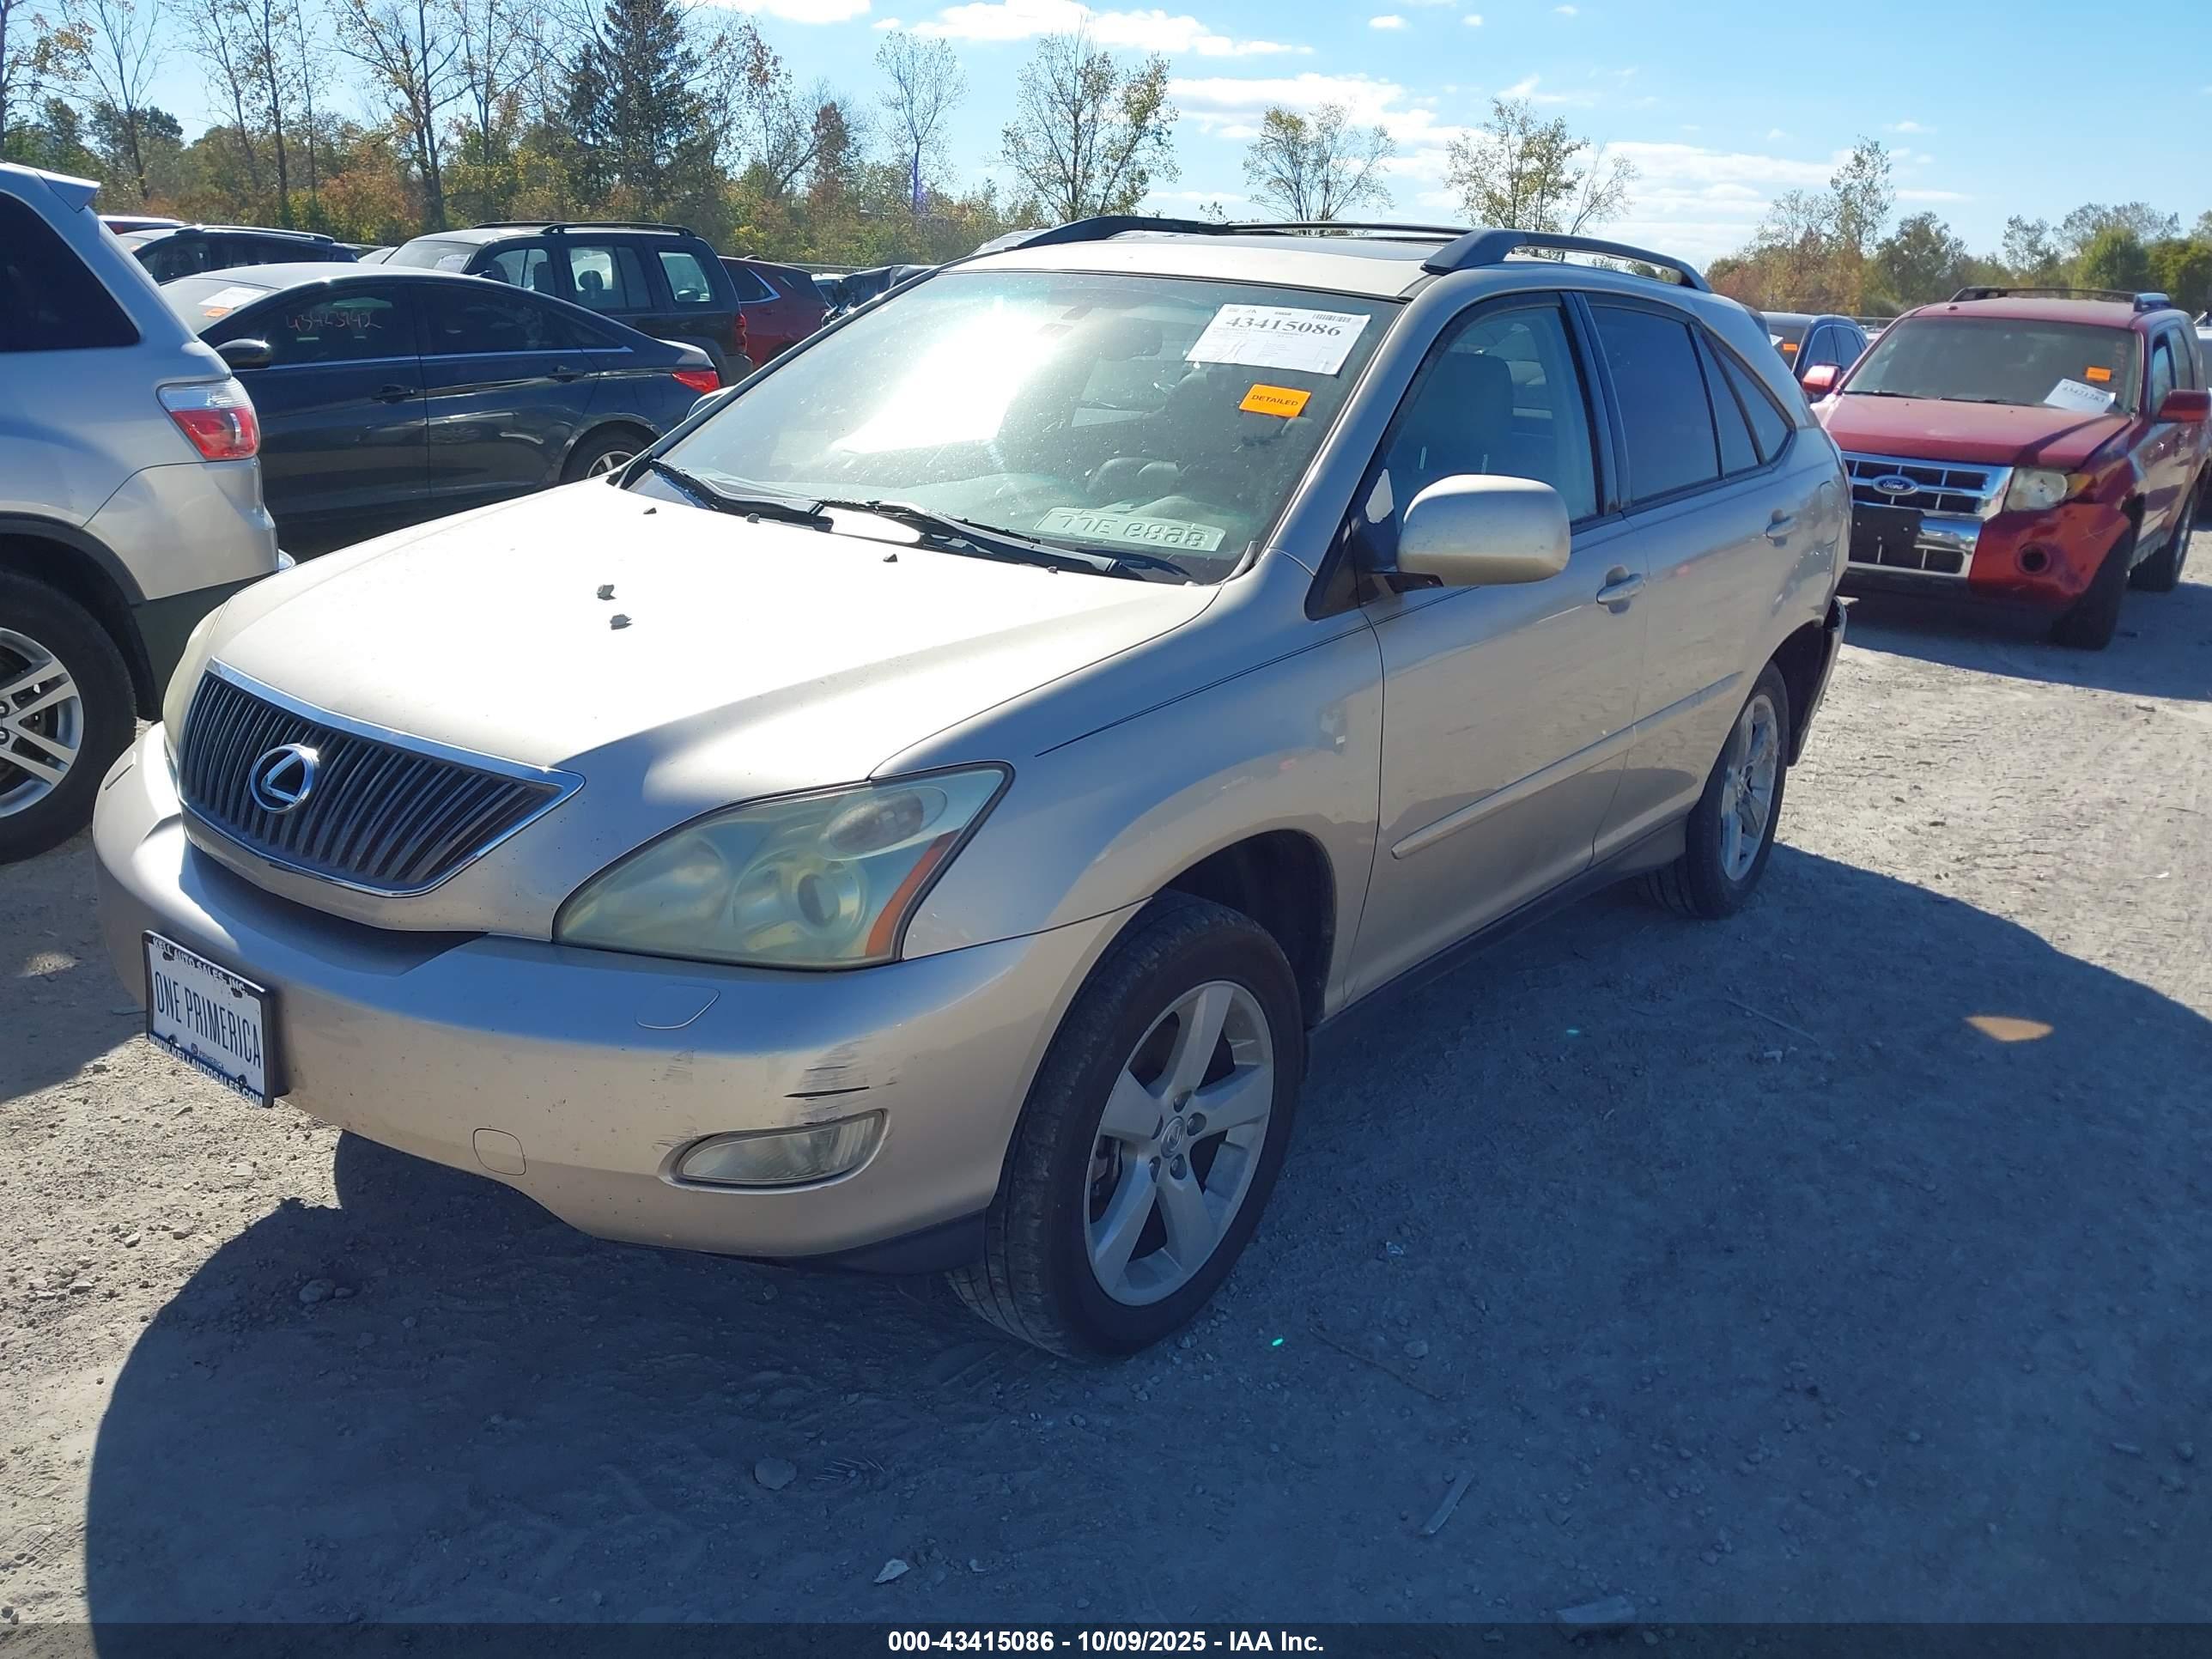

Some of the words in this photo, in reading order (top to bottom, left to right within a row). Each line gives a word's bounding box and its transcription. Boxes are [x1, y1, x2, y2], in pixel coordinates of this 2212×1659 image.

[1226, 317, 1346, 337] 43415086
[1250, 394, 1299, 407] DETAILED
[1882, 479, 1905, 489] Ford
[173, 949, 195, 969] AUTO
[197, 961, 225, 982] SALES
[155, 971, 182, 1024] ONE
[185, 987, 262, 1070] PRIMERICA
[149, 1032, 264, 1108] WWW.KELLAUTOSALES.COM
